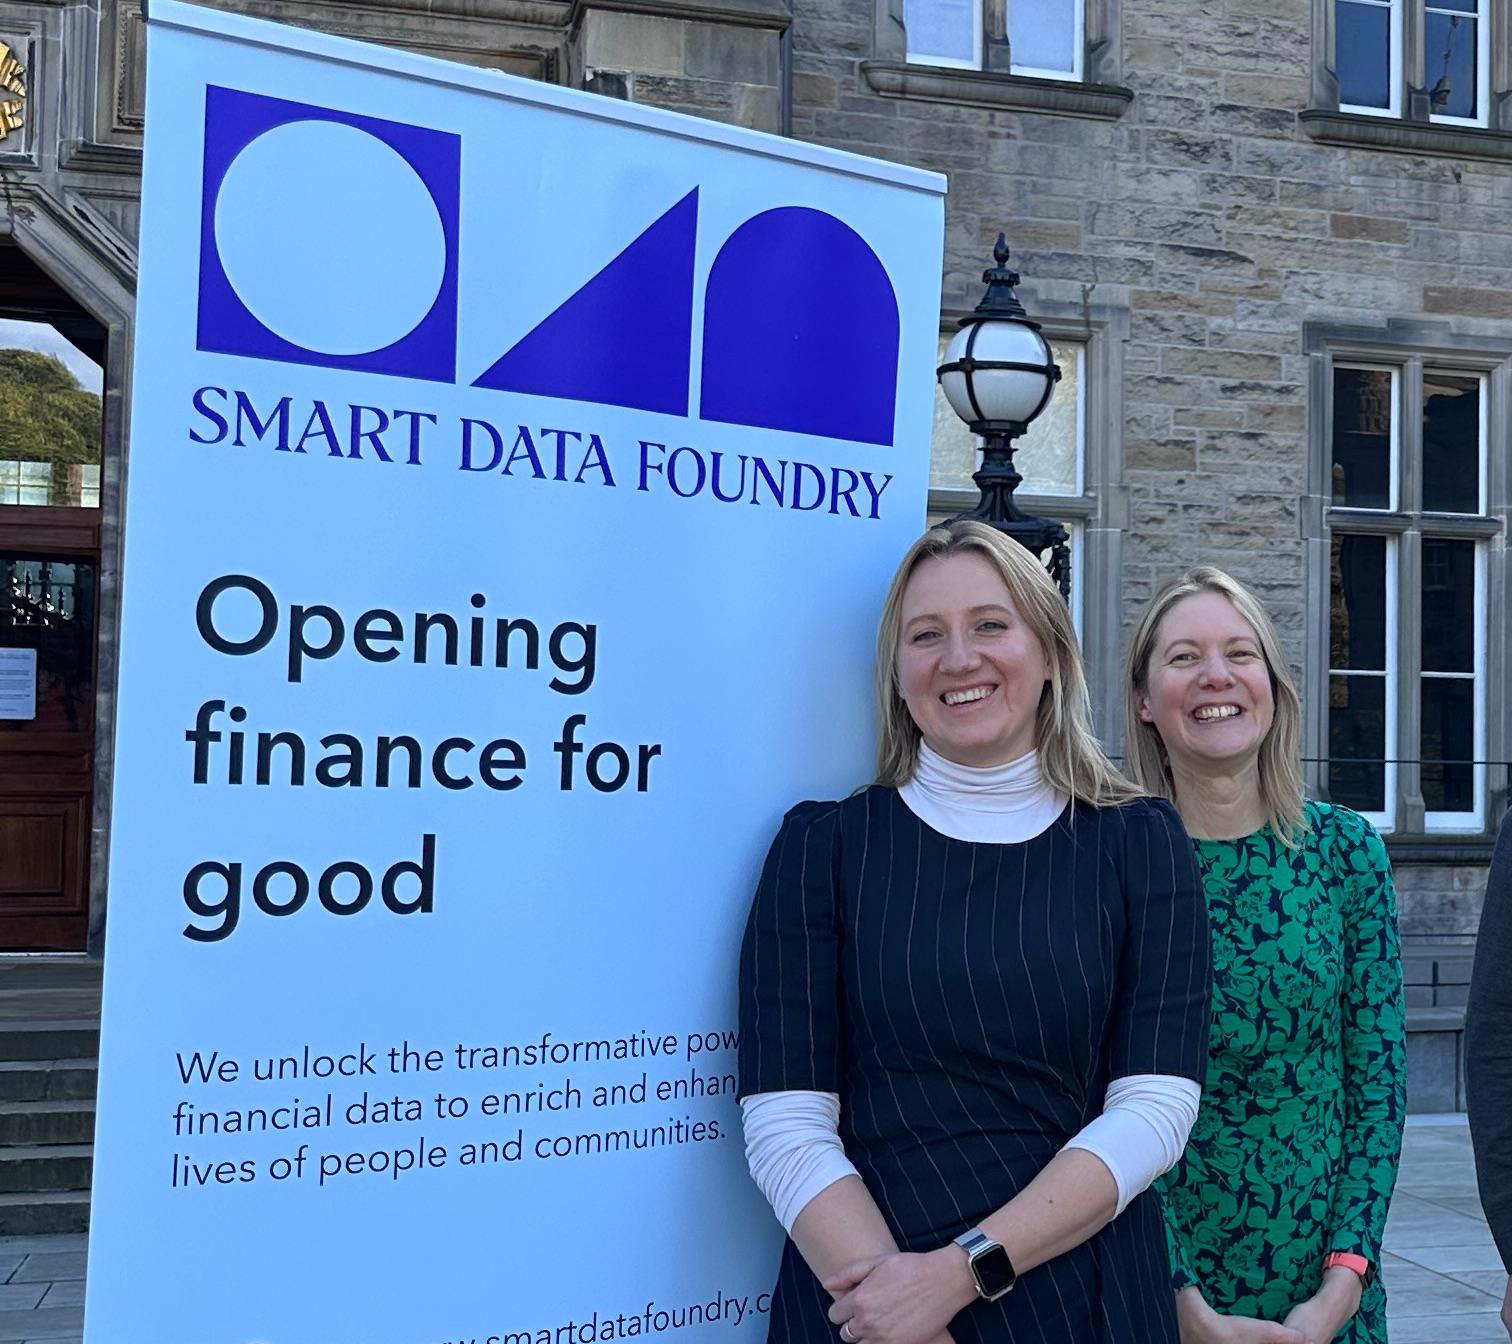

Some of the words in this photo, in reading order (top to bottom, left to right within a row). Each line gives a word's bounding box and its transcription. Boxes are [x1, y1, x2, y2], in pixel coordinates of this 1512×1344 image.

[189, 386, 438, 466] SMART
[458, 417, 617, 488] DATA
[636, 440, 894, 520] FOUNDRY
[195, 574, 598, 696] Opening
[185, 699, 527, 791] finance
[553, 713, 662, 793] for
[182, 833, 436, 943] good
[172, 1093, 332, 1136] financial
[345, 1091, 422, 1125] data
[434, 1093, 469, 1119] to
[481, 1078, 581, 1116] enrich
[592, 1072, 647, 1107] and
[656, 1067, 736, 1102] enhan
[176, 1051, 239, 1084] We
[254, 1042, 377, 1081] unlock
[387, 1040, 444, 1074] the
[454, 1029, 678, 1070] transformative
[687, 1031, 740, 1063] pow
[172, 1154, 256, 1188] lives
[269, 1144, 309, 1180] of
[319, 1136, 447, 1187] people
[459, 1129, 523, 1166] and
[535, 1115, 726, 1159] communities.
